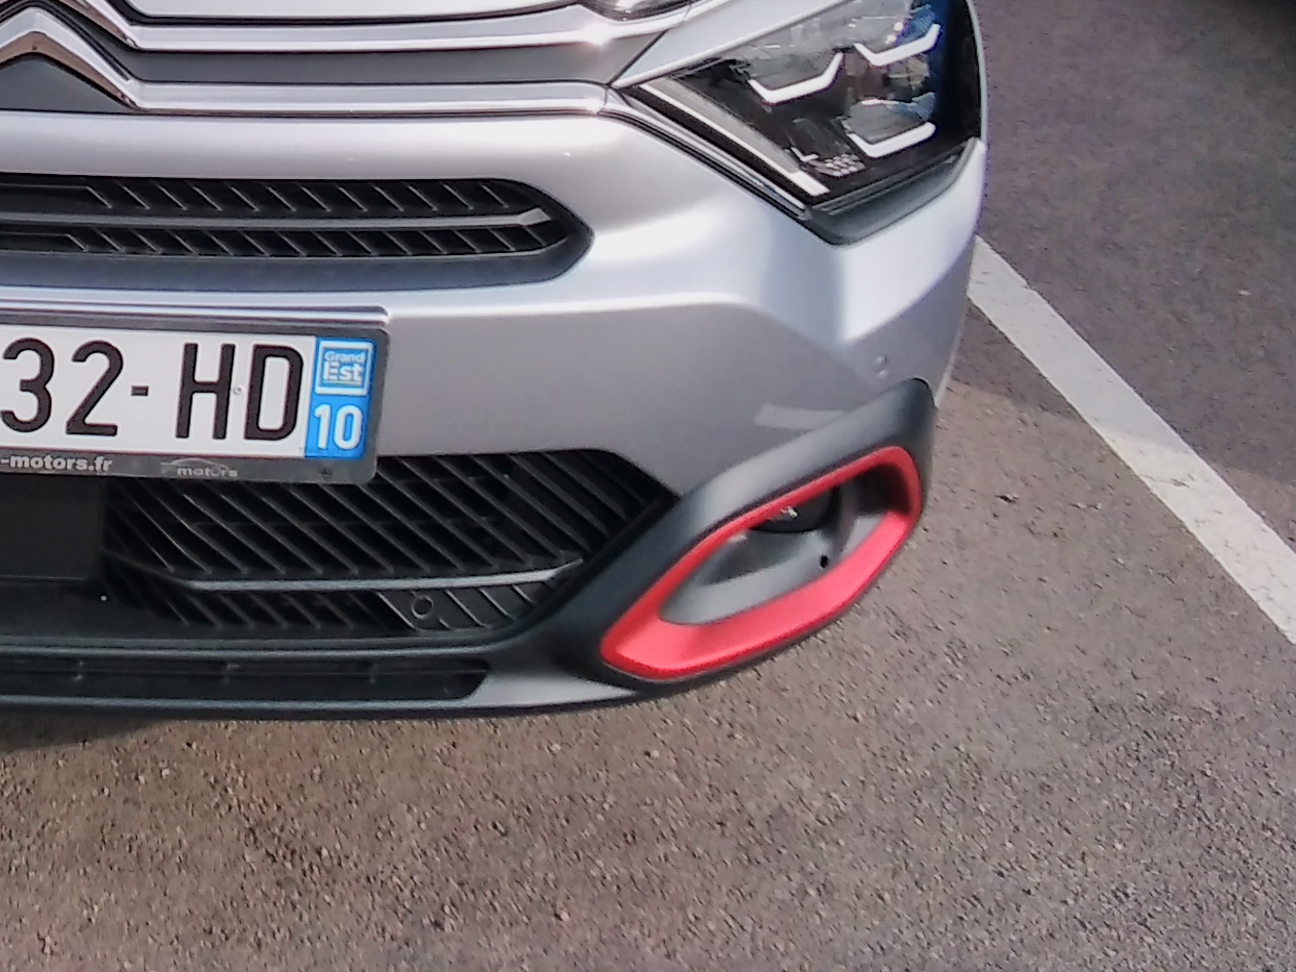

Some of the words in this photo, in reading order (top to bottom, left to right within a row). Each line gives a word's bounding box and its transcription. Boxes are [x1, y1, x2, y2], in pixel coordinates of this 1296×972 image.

[324, 351, 366, 364] Grand
[323, 361, 363, 382] Est
[314, 403, 364, 450] 10
